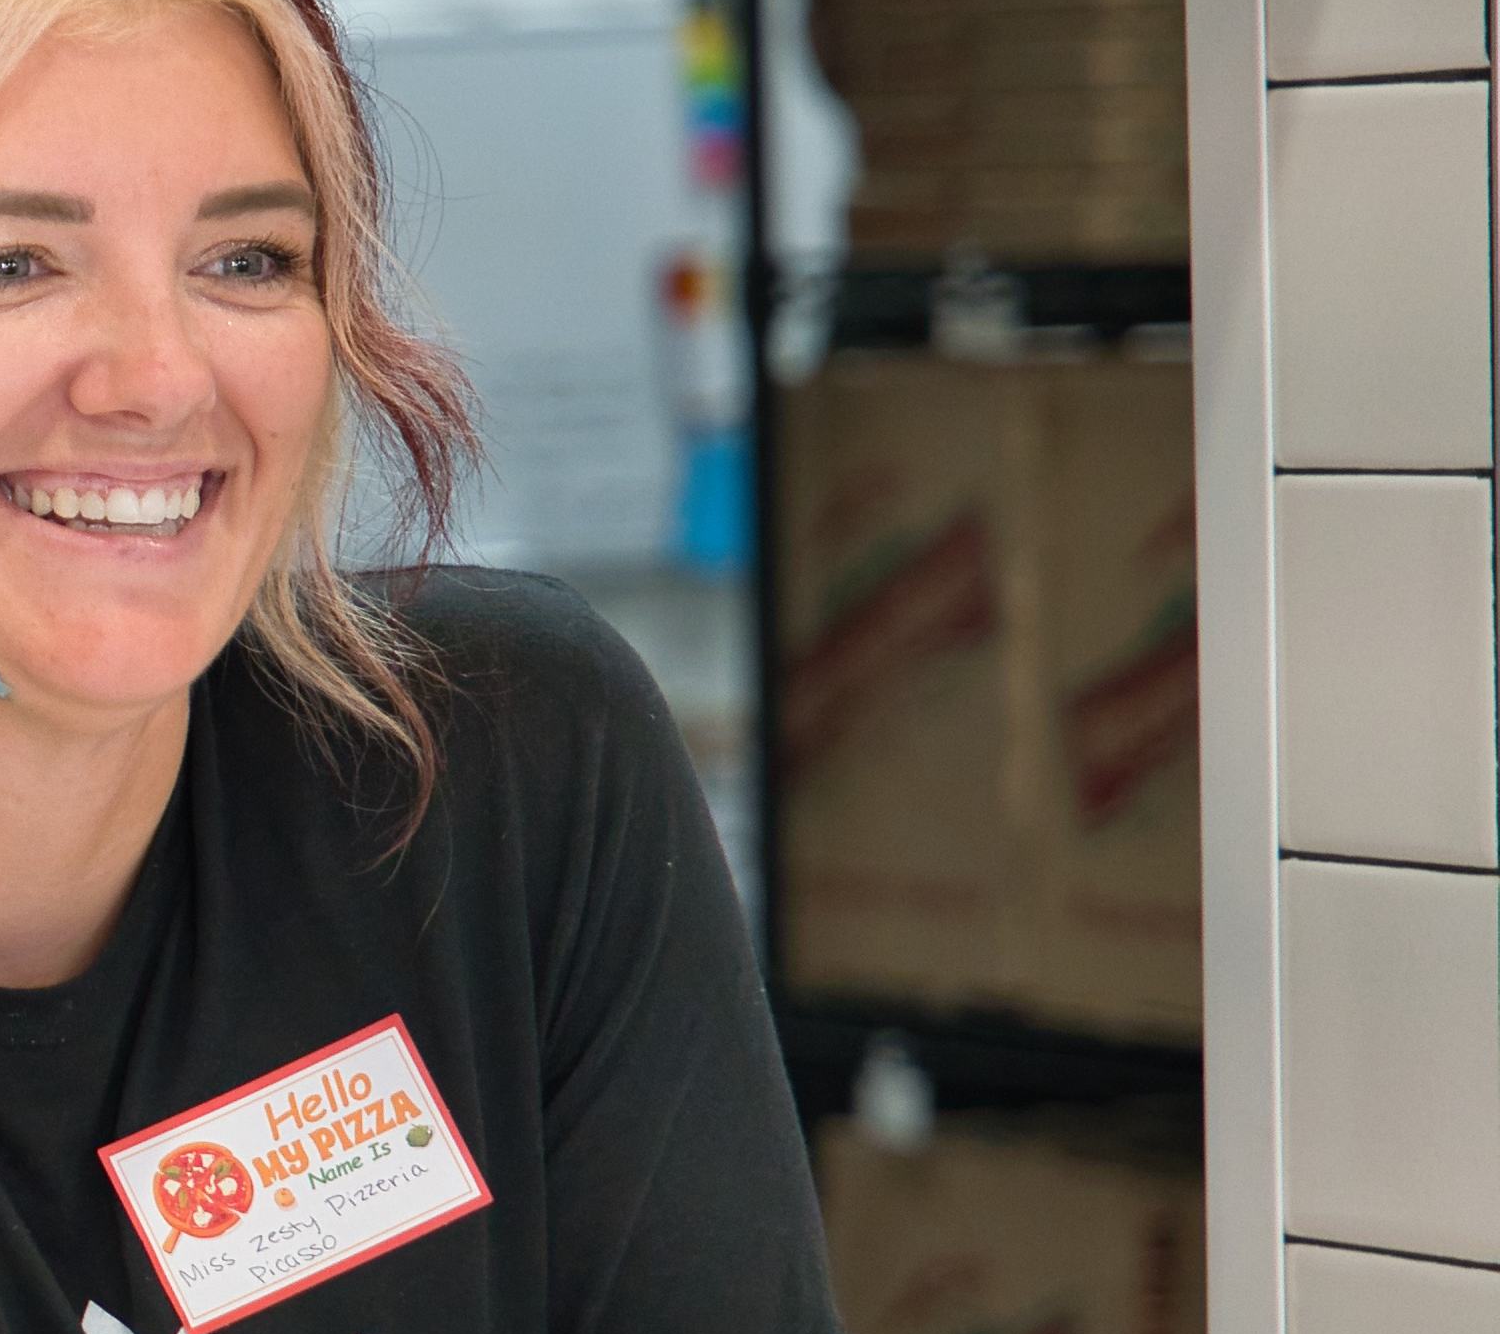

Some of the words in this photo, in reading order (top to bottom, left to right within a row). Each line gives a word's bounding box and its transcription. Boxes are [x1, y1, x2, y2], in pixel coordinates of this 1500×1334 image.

[252, 1139, 310, 1188] MY
[308, 1090, 422, 1161] PIZZA
[264, 1069, 371, 1141] Hello
[307, 1155, 363, 1190] Name
[368, 1141, 392, 1162] Is
[179, 1252, 235, 1287] Miss
[324, 1163, 429, 1216] Pizzeria
[249, 1234, 337, 1284] Picasso
